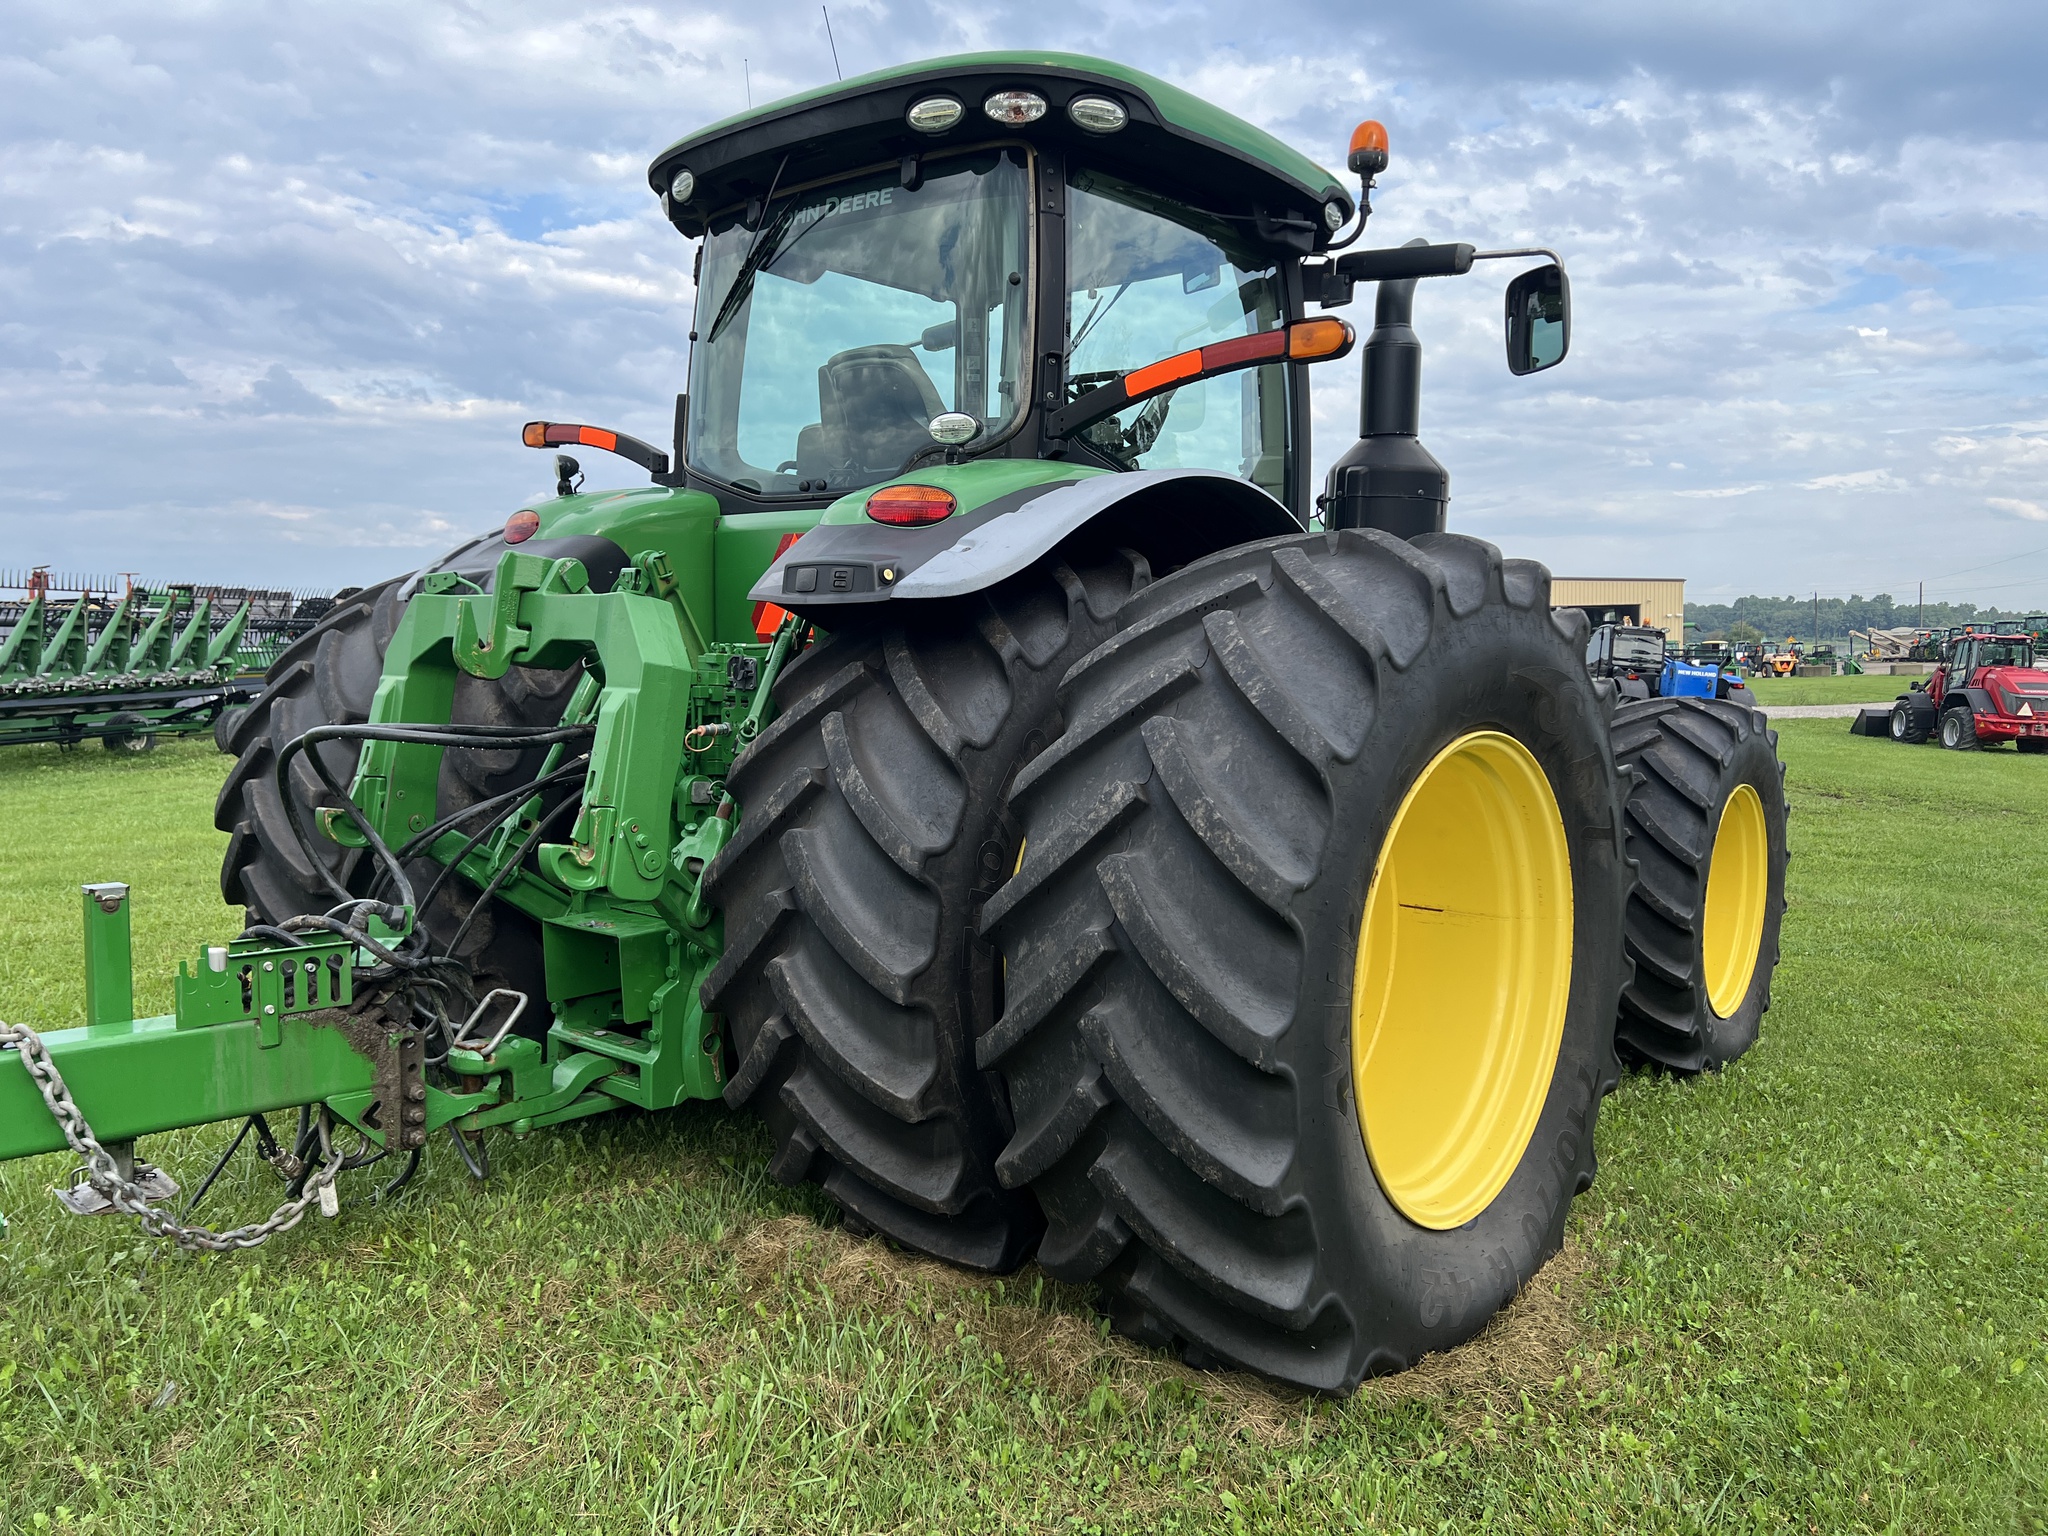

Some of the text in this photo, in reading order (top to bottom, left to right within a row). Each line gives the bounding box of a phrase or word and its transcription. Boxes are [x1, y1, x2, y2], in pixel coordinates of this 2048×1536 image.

[776, 187, 894, 229] OHN DEERE
[1691, 670, 1717, 678] HOLLAND
